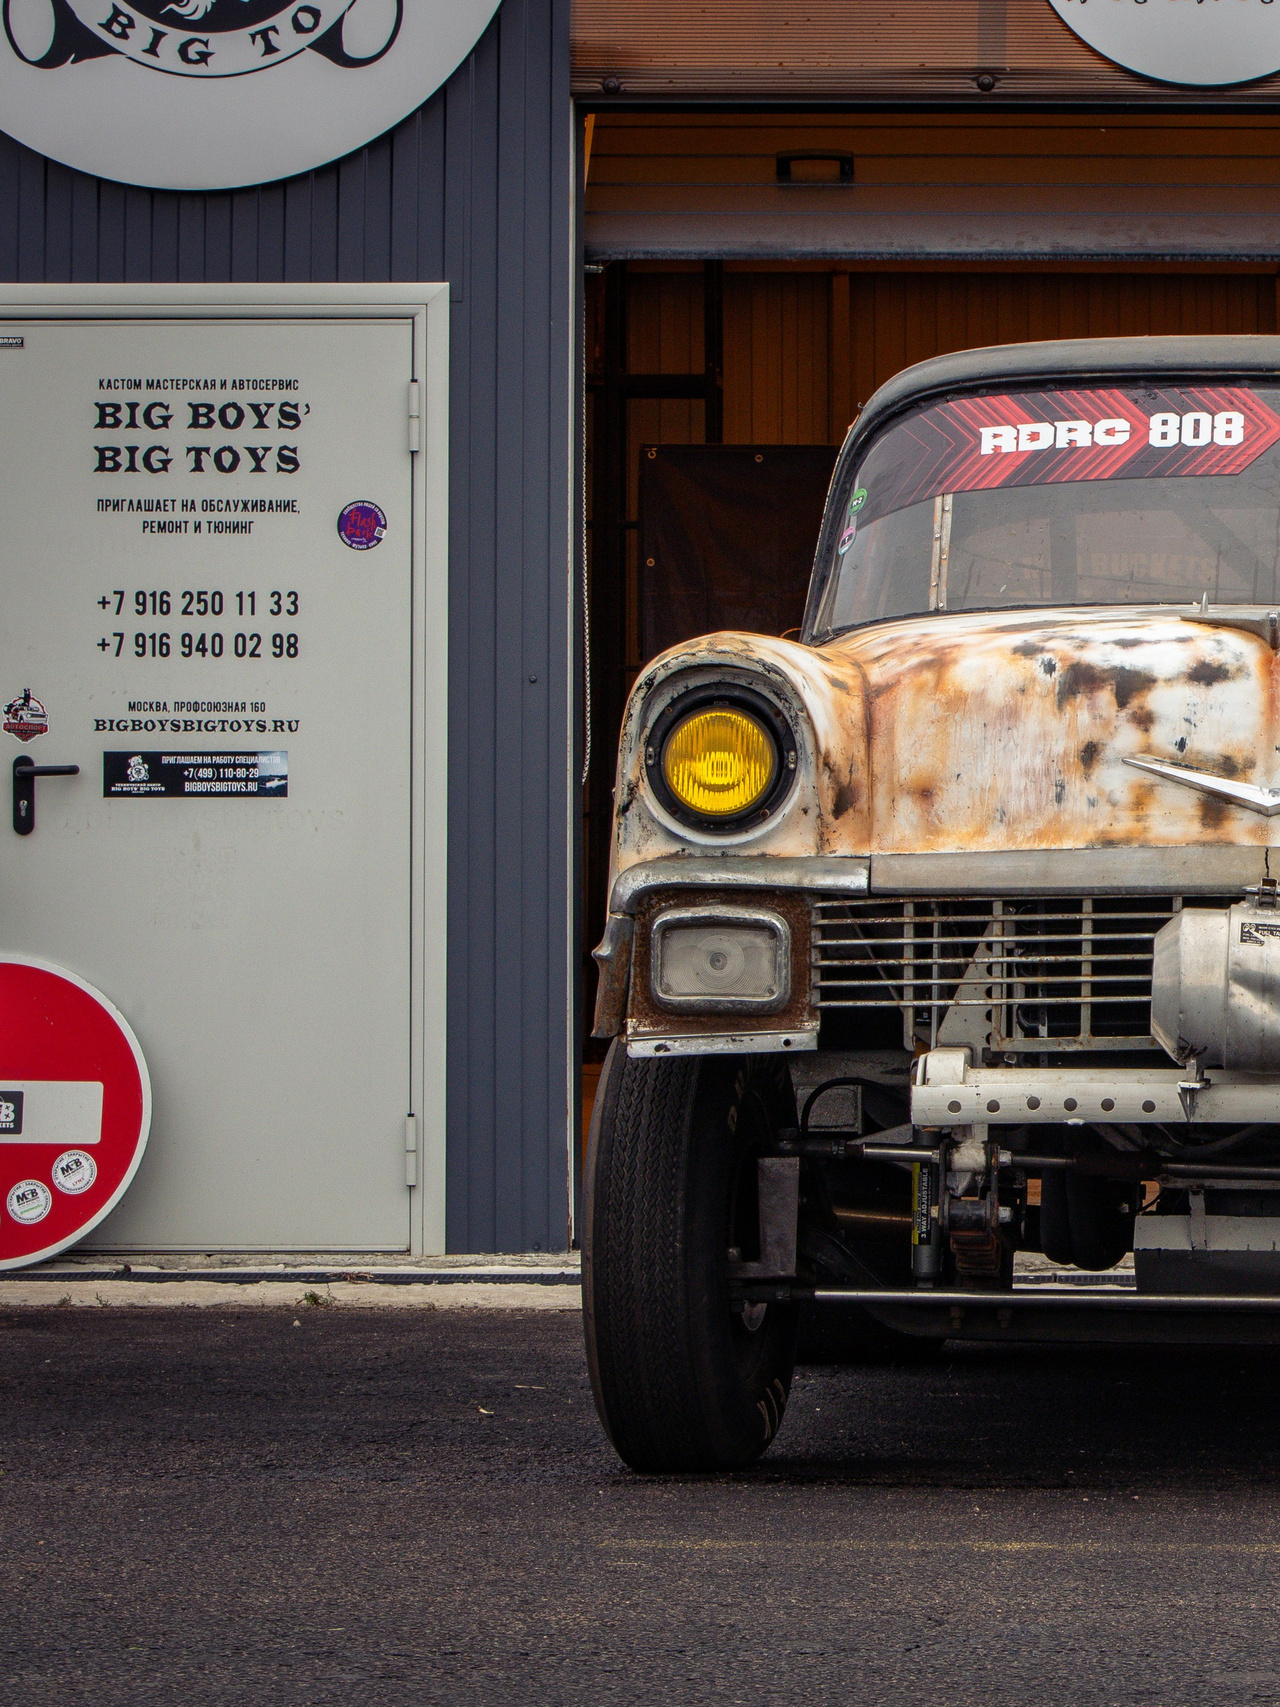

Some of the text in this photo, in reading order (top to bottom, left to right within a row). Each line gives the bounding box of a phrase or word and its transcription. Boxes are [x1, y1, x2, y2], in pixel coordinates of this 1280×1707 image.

[98, 3, 215, 67] BIG
[99, 378, 299, 391] КАСТОМ МАСТЕРСКАЯ И АВТОСЕРВИС
[93, 401, 174, 430] BIG
[980, 411, 1245, 455] RDRC 808
[93, 445, 301, 474] BIG TOYS
[97, 499, 301, 515] ПРИГЛАШАЕТ НА ОБСЛУЖИВАНИЕ,
[143, 521, 255, 534] РЕМОНТ И ТЮНИНГ
[97, 591, 299, 616] +7 916 250 11 33
[97, 633, 299, 658] +7 916 940 02 98
[128, 701, 266, 714] МОСКВА, ПРОФСОЮЗНАЯ 160
[94, 718, 300, 733] BIGBOYSBIGTOYS.RU
[162, 756, 281, 765] ПРИГЛАШАЕМ НА РАБОТУ СПЕЦИАЛИСТОВ
[184, 768, 217, 780] +7(499)
[184, 781, 258, 792] BIGBOYSBIGTOYS.RU
